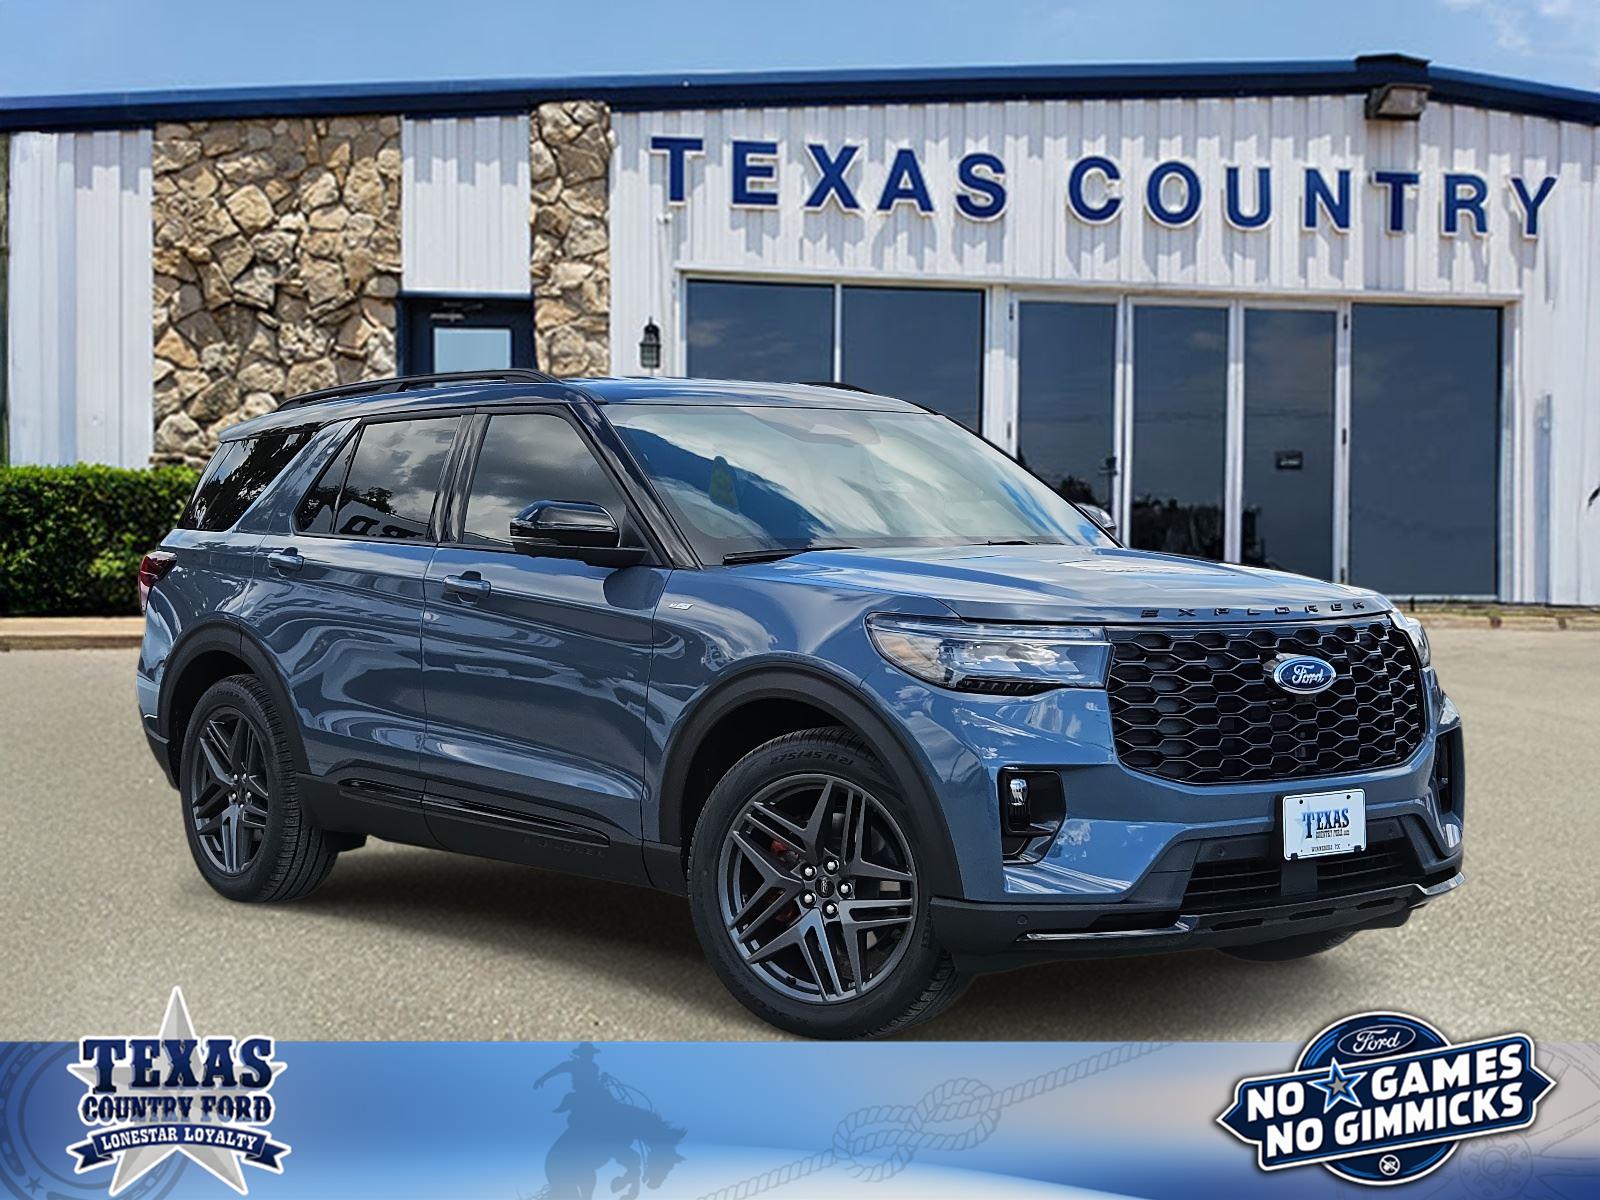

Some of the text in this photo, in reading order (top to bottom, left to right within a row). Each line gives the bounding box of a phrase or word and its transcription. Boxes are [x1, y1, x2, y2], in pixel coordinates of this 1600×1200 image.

[650, 135, 1557, 239] TEXAS COUNTRY
[1140, 600, 1365, 618] EXPLORER
[1302, 807, 1350, 839] TEXAS
